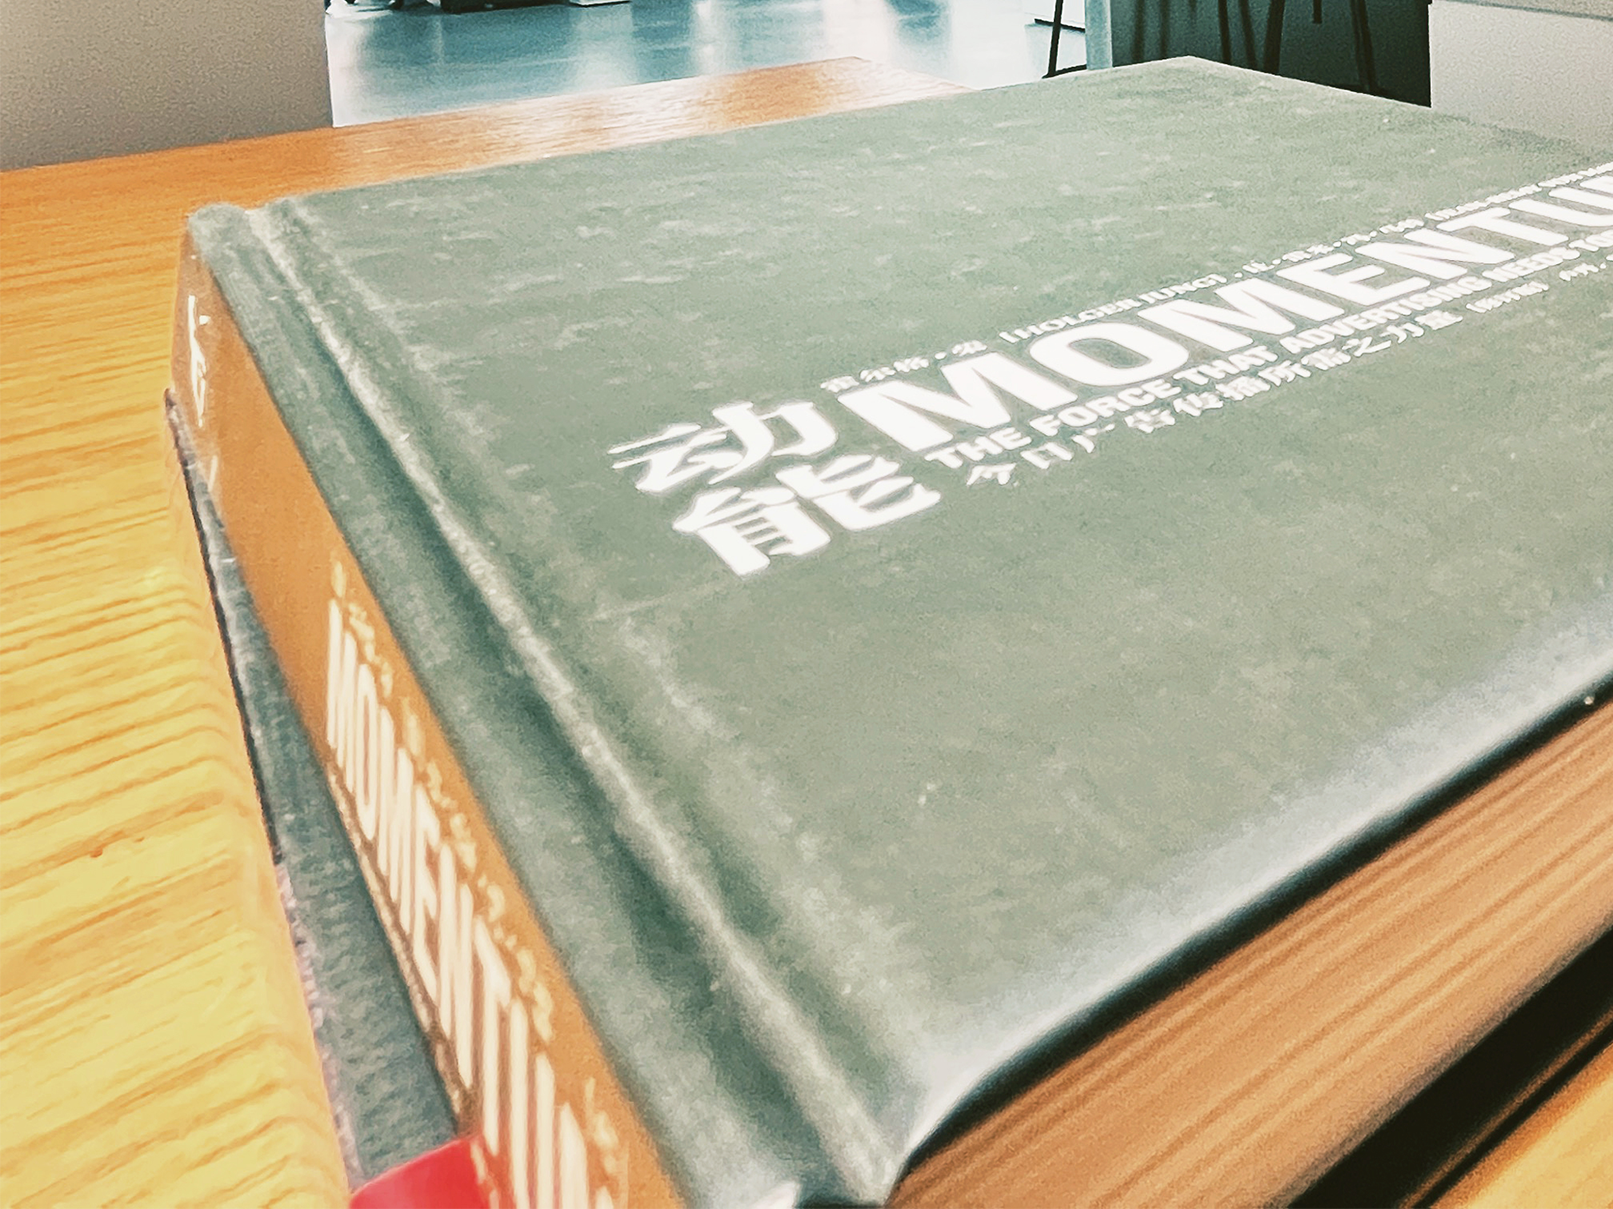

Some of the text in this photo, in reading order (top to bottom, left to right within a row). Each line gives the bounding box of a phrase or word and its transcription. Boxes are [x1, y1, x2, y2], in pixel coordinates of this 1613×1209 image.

[925, 427, 1032, 468] THE
[1029, 379, 1181, 436] FORCE
[1173, 346, 1278, 386] THAT
[1280, 276, 1493, 354] ADVERTISING
[1482, 247, 1580, 283] NEEDS
